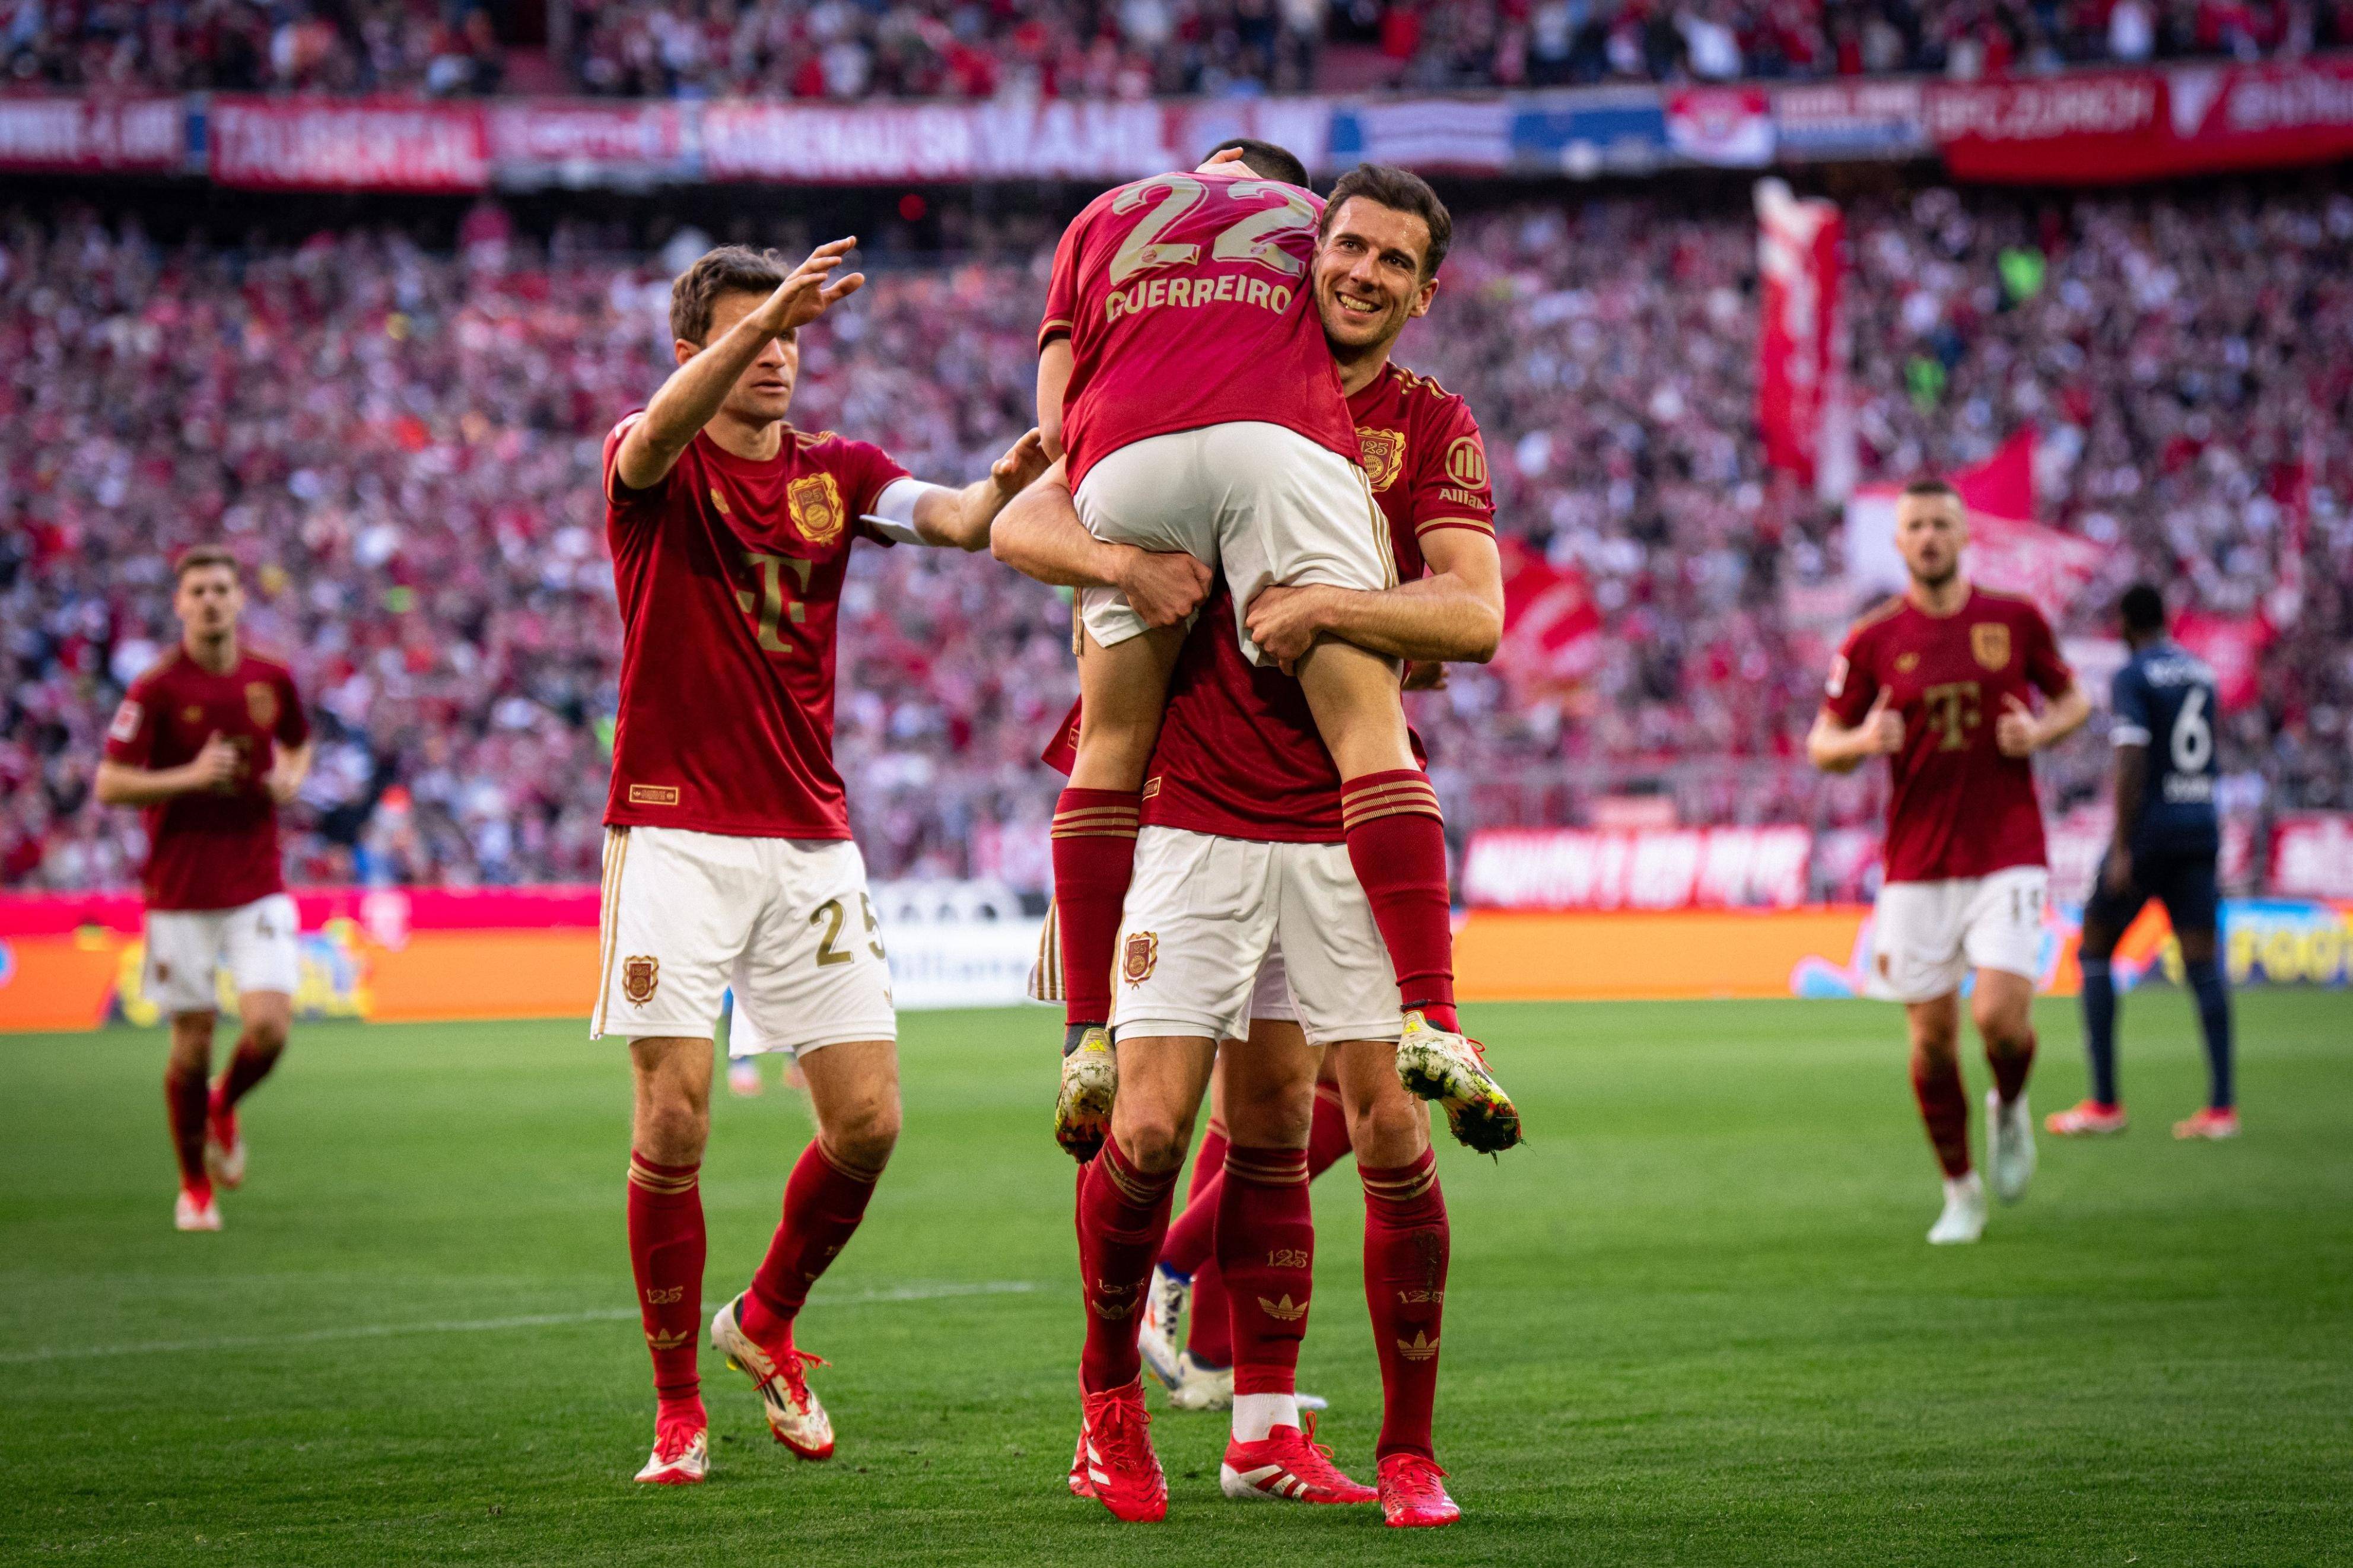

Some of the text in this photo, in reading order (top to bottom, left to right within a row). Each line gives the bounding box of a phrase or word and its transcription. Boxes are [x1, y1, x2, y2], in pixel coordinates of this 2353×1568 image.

[1109, 176, 1319, 287] 22
[1105, 275, 1292, 323] GUERREIRO
[1361, 440, 1388, 456] 125
[1438, 488, 1487, 509] Allian
[2170, 685, 2212, 772] 6
[809, 892, 886, 969] 25
[1267, 1248, 1308, 1268] 125
[646, 1285, 683, 1305] 125
[1397, 1290, 1443, 1305] 125
